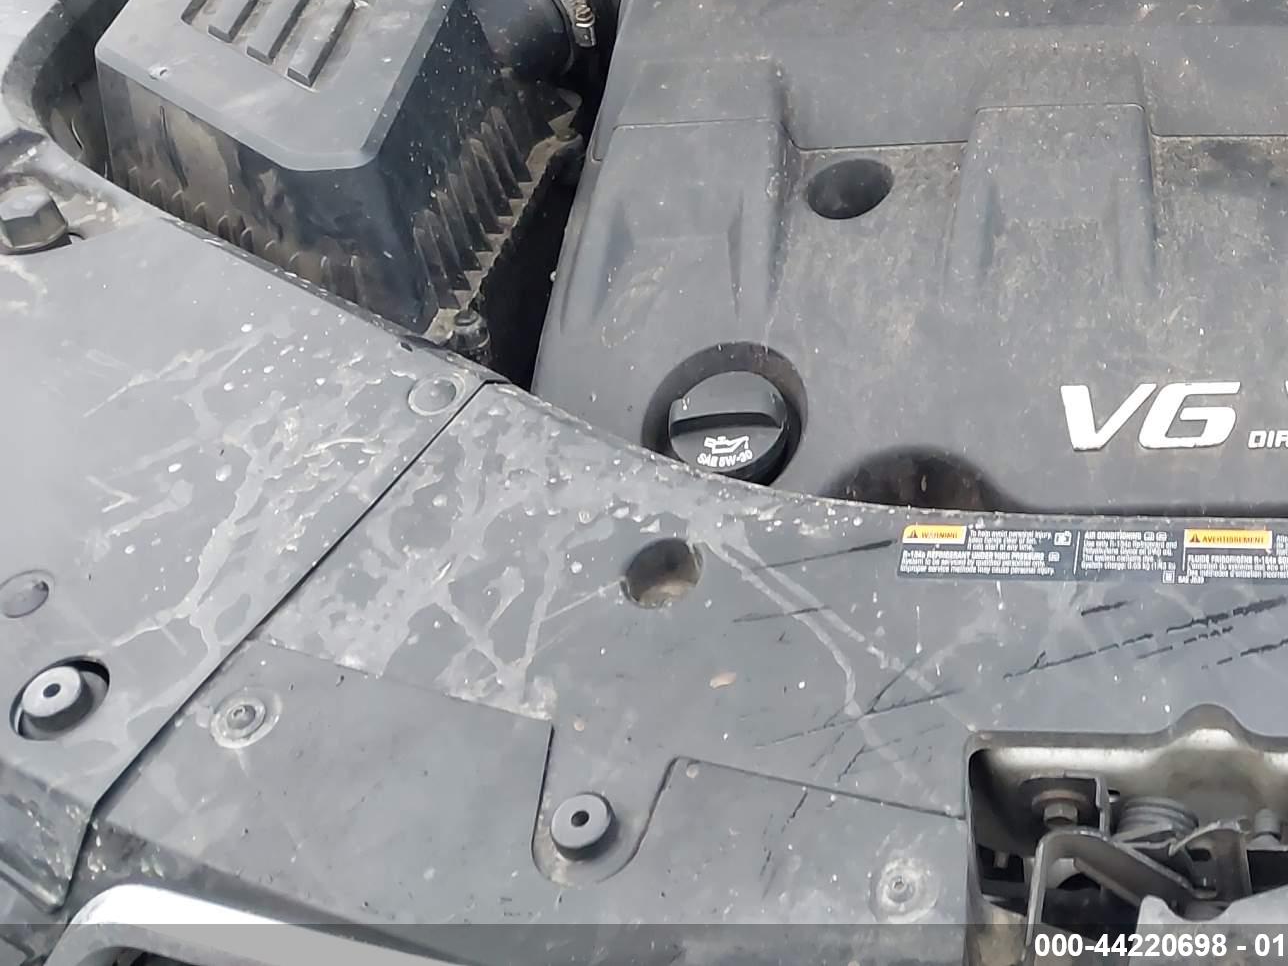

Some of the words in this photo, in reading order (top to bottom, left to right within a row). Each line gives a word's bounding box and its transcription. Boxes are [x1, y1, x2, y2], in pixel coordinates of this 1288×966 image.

[1060, 380, 1241, 452] V6
[697, 452, 718, 467] SAE
[718, 449, 753, 468] 5W-30
